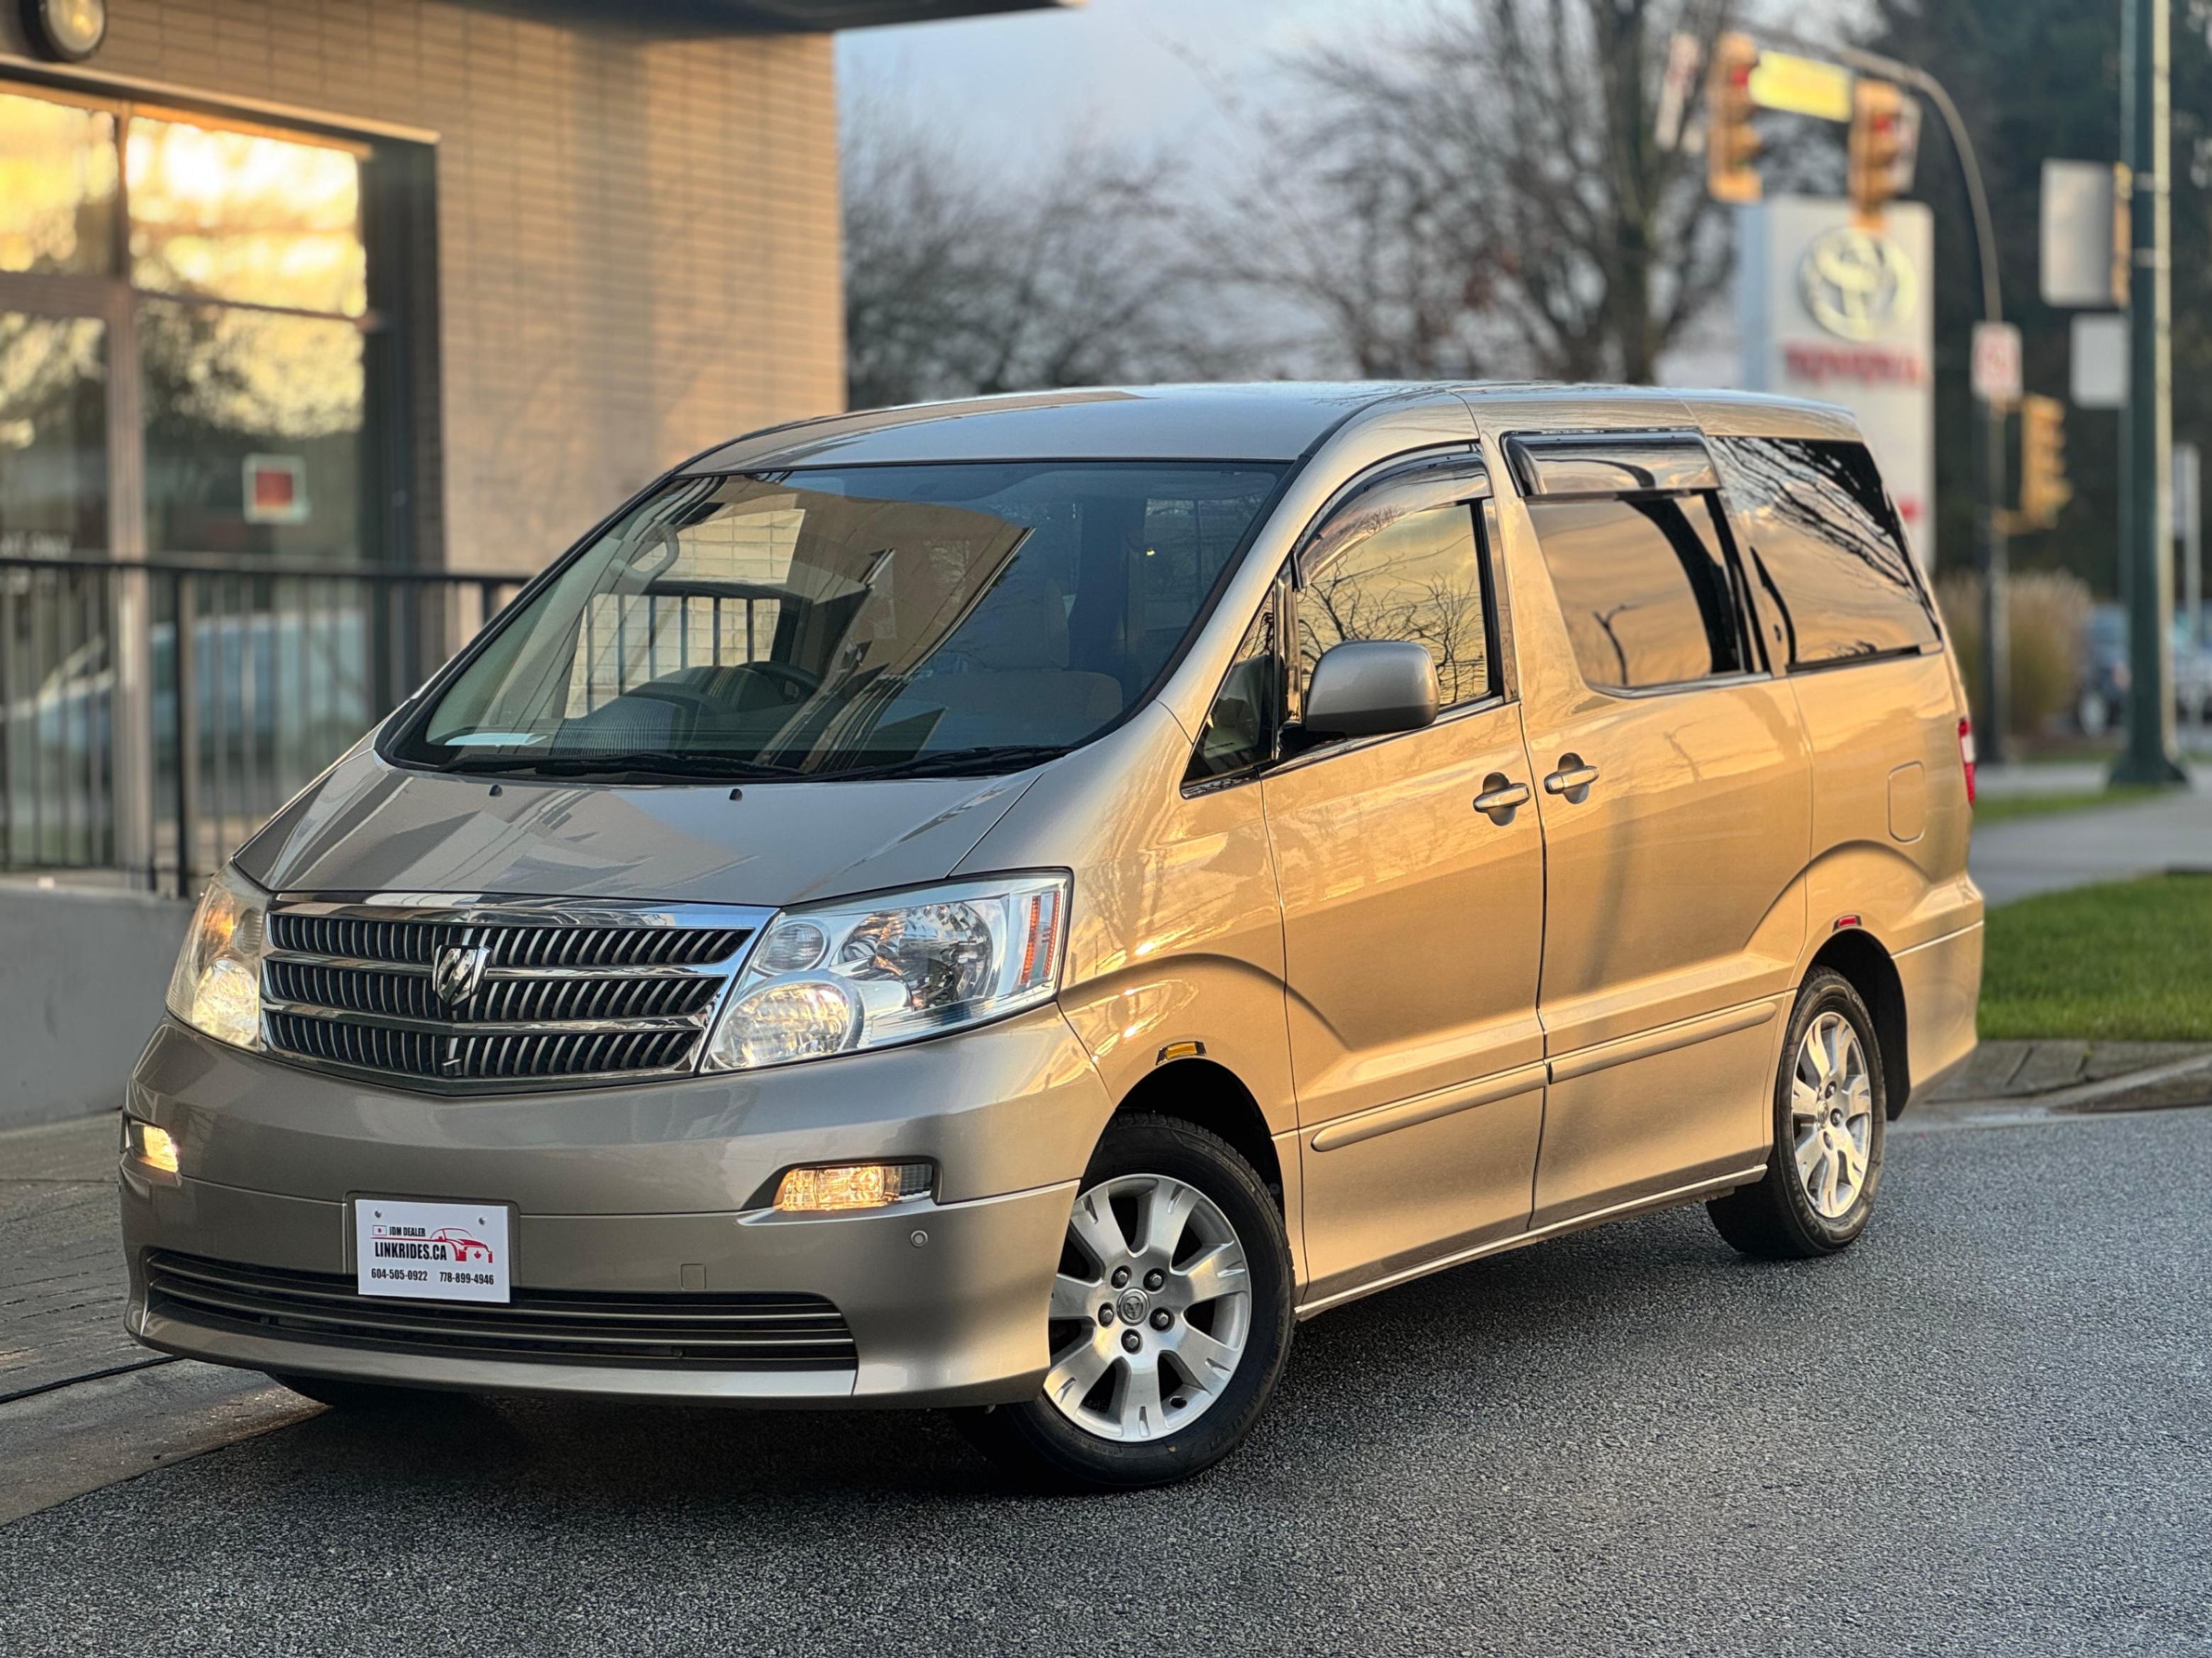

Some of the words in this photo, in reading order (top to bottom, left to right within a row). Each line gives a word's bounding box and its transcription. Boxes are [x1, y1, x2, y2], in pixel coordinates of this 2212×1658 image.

[389, 1226, 402, 1236] JDM
[403, 1227, 426, 1237] DEALER
[375, 1242, 448, 1261] LINKRIDES.CA
[371, 1268, 428, 1281] 604-505-0922
[439, 1271, 494, 1285] 778-899-4946
